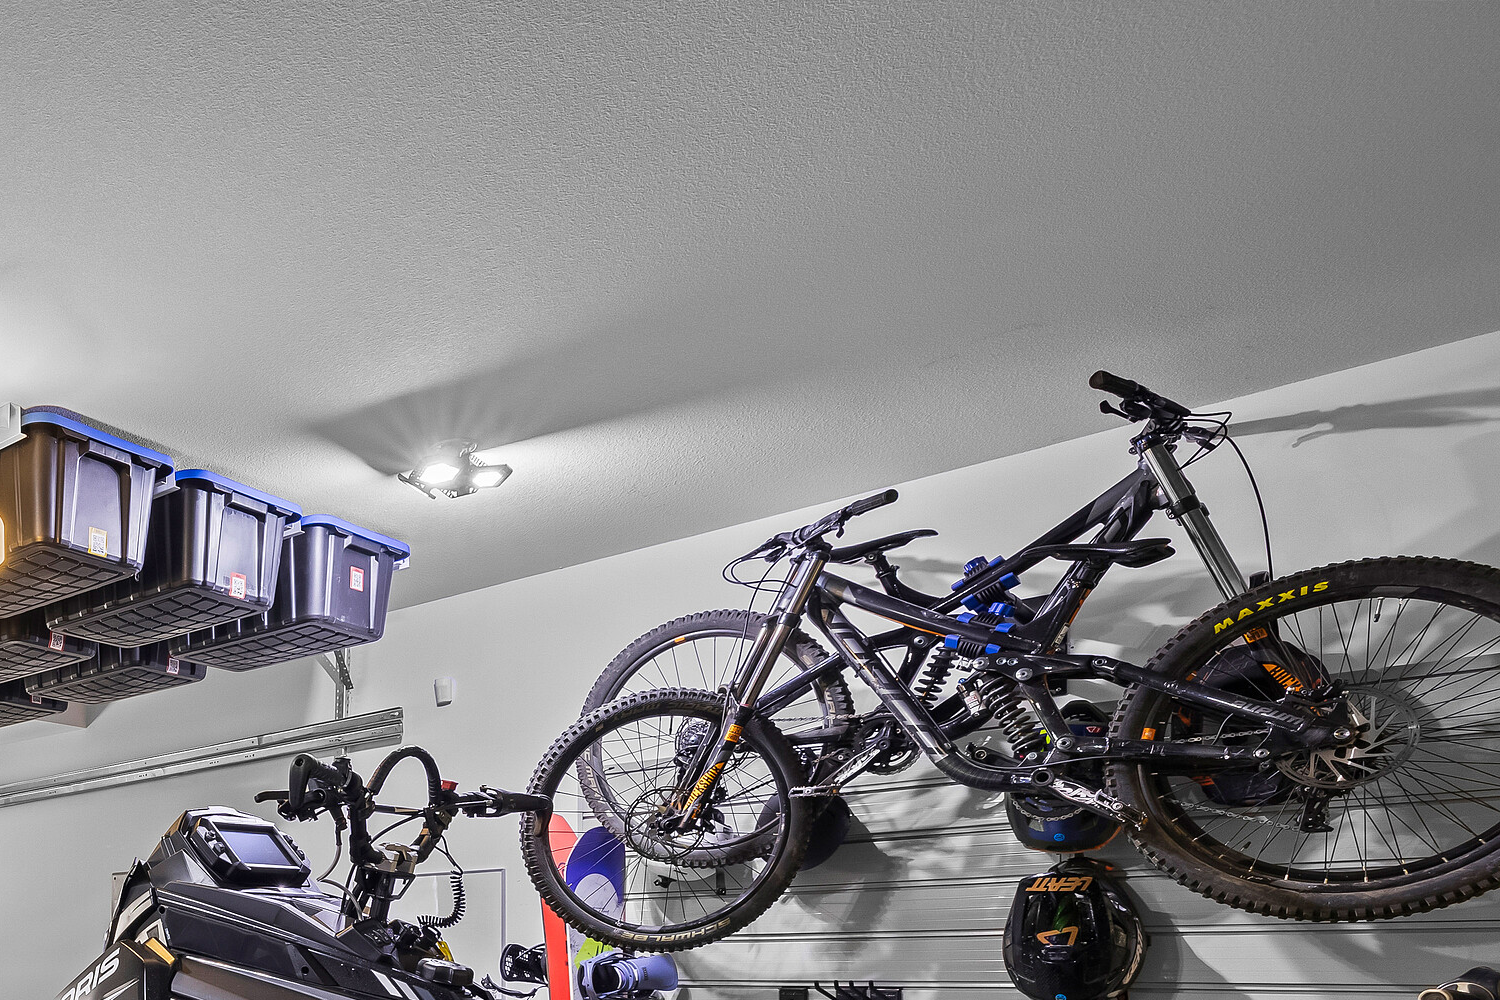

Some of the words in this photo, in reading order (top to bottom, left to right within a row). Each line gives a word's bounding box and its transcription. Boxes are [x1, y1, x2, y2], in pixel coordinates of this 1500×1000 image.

[1214, 581, 1330, 635] MAXXIS
[1025, 876, 1093, 892] LEATT
[621, 917, 731, 942] SCHWALBE
